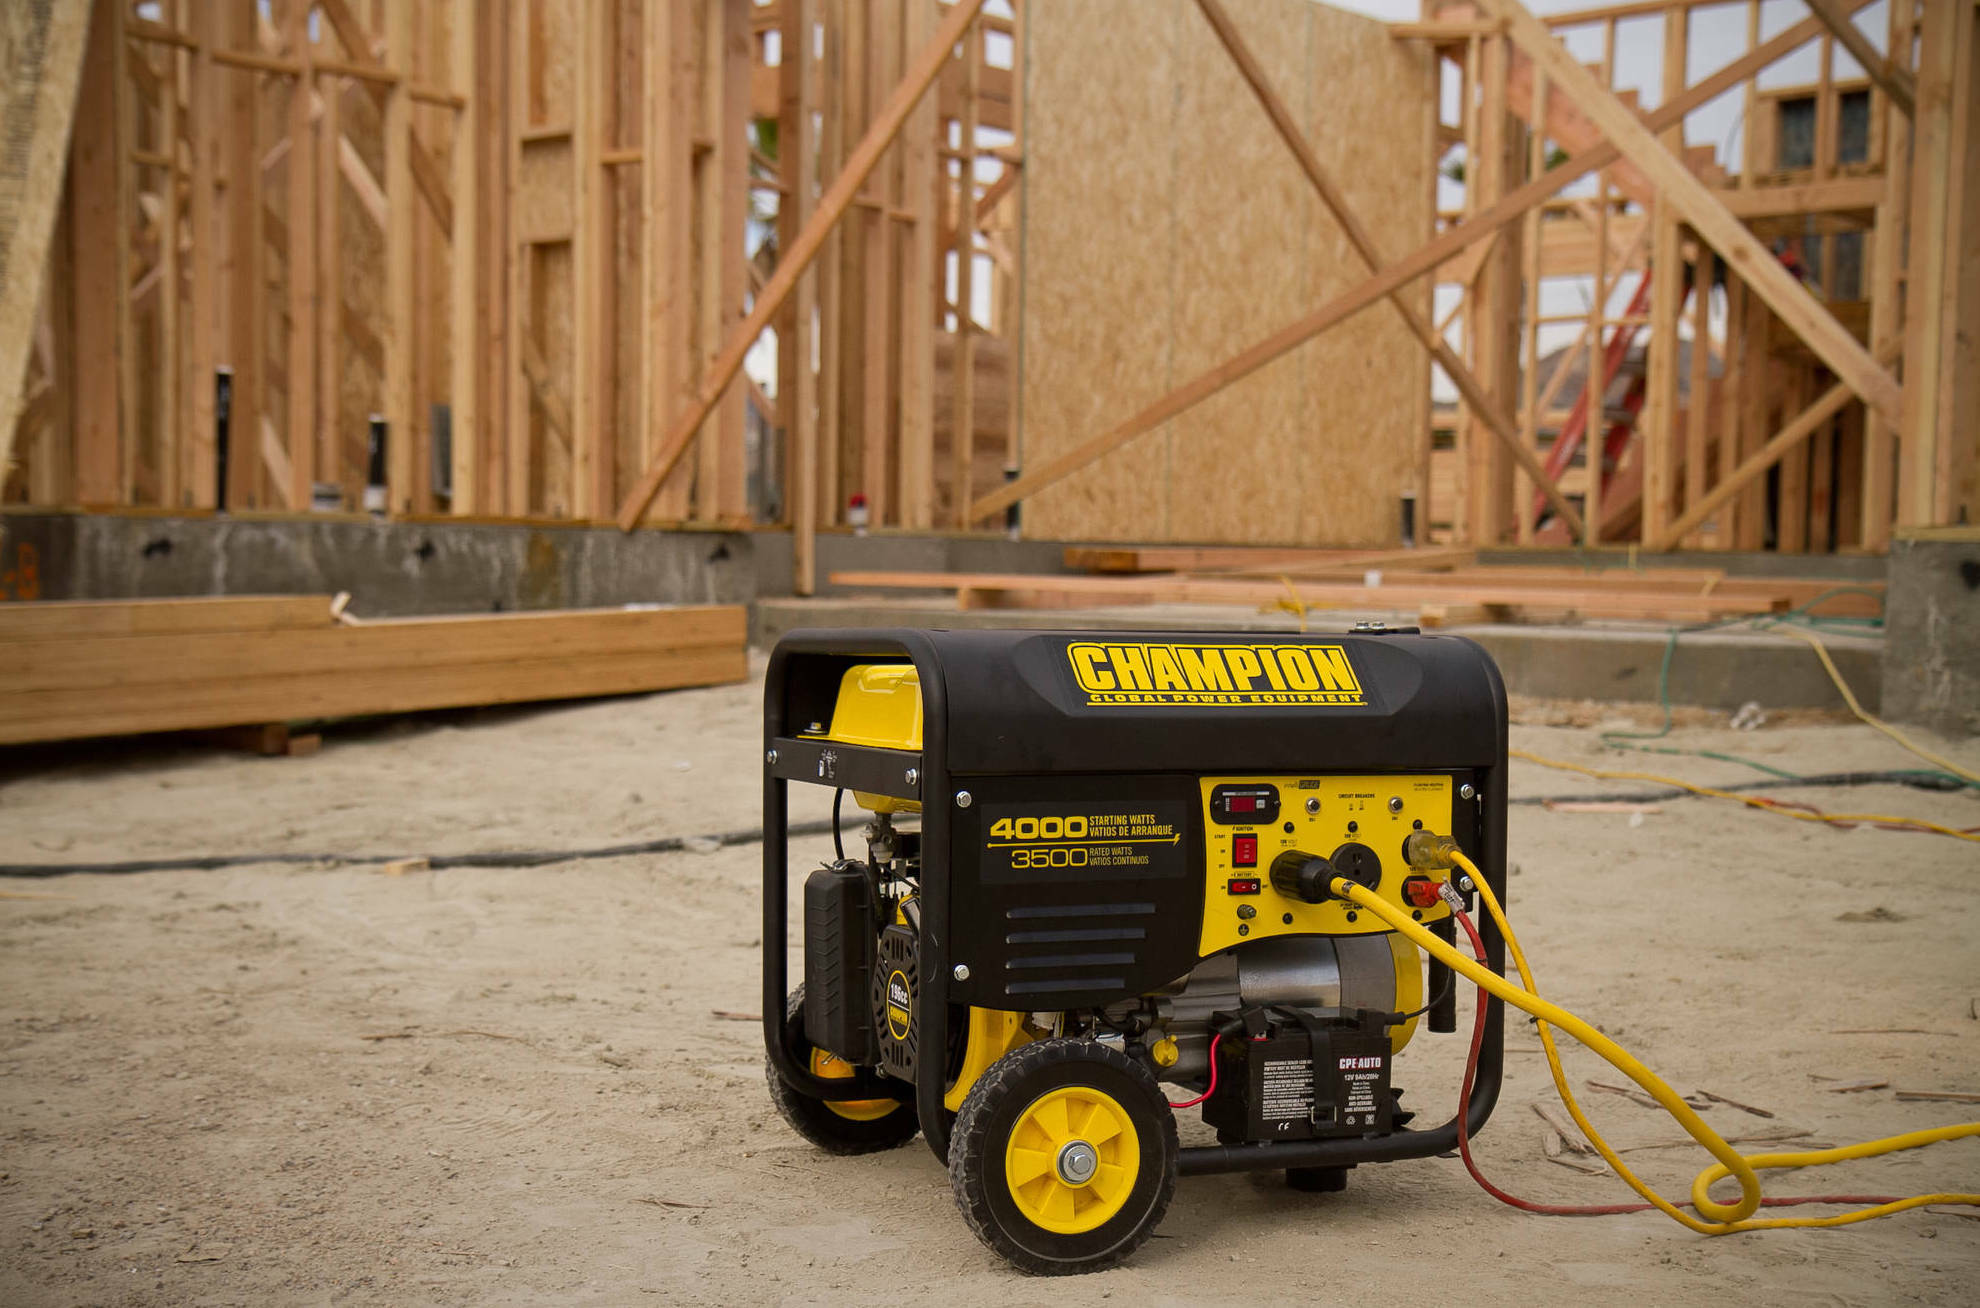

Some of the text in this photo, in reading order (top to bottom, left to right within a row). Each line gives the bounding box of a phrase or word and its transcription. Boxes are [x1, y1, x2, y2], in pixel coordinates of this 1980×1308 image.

[1068, 643, 1361, 693] CHAMPION
[1089, 694, 1362, 703] GLOBAL POWER EQUIPMENT
[1089, 814, 1156, 826] STARTING WATTS
[990, 816, 1089, 840] 4000
[1089, 824, 1173, 837] VATIOS DE ARRANQUE
[1089, 846, 1133, 856] RATED WATTS
[1011, 848, 1089, 869] 3500
[1089, 855, 1149, 866] VATIOS CONTINUOS
[1339, 1057, 1381, 1070] CPE AUTO
